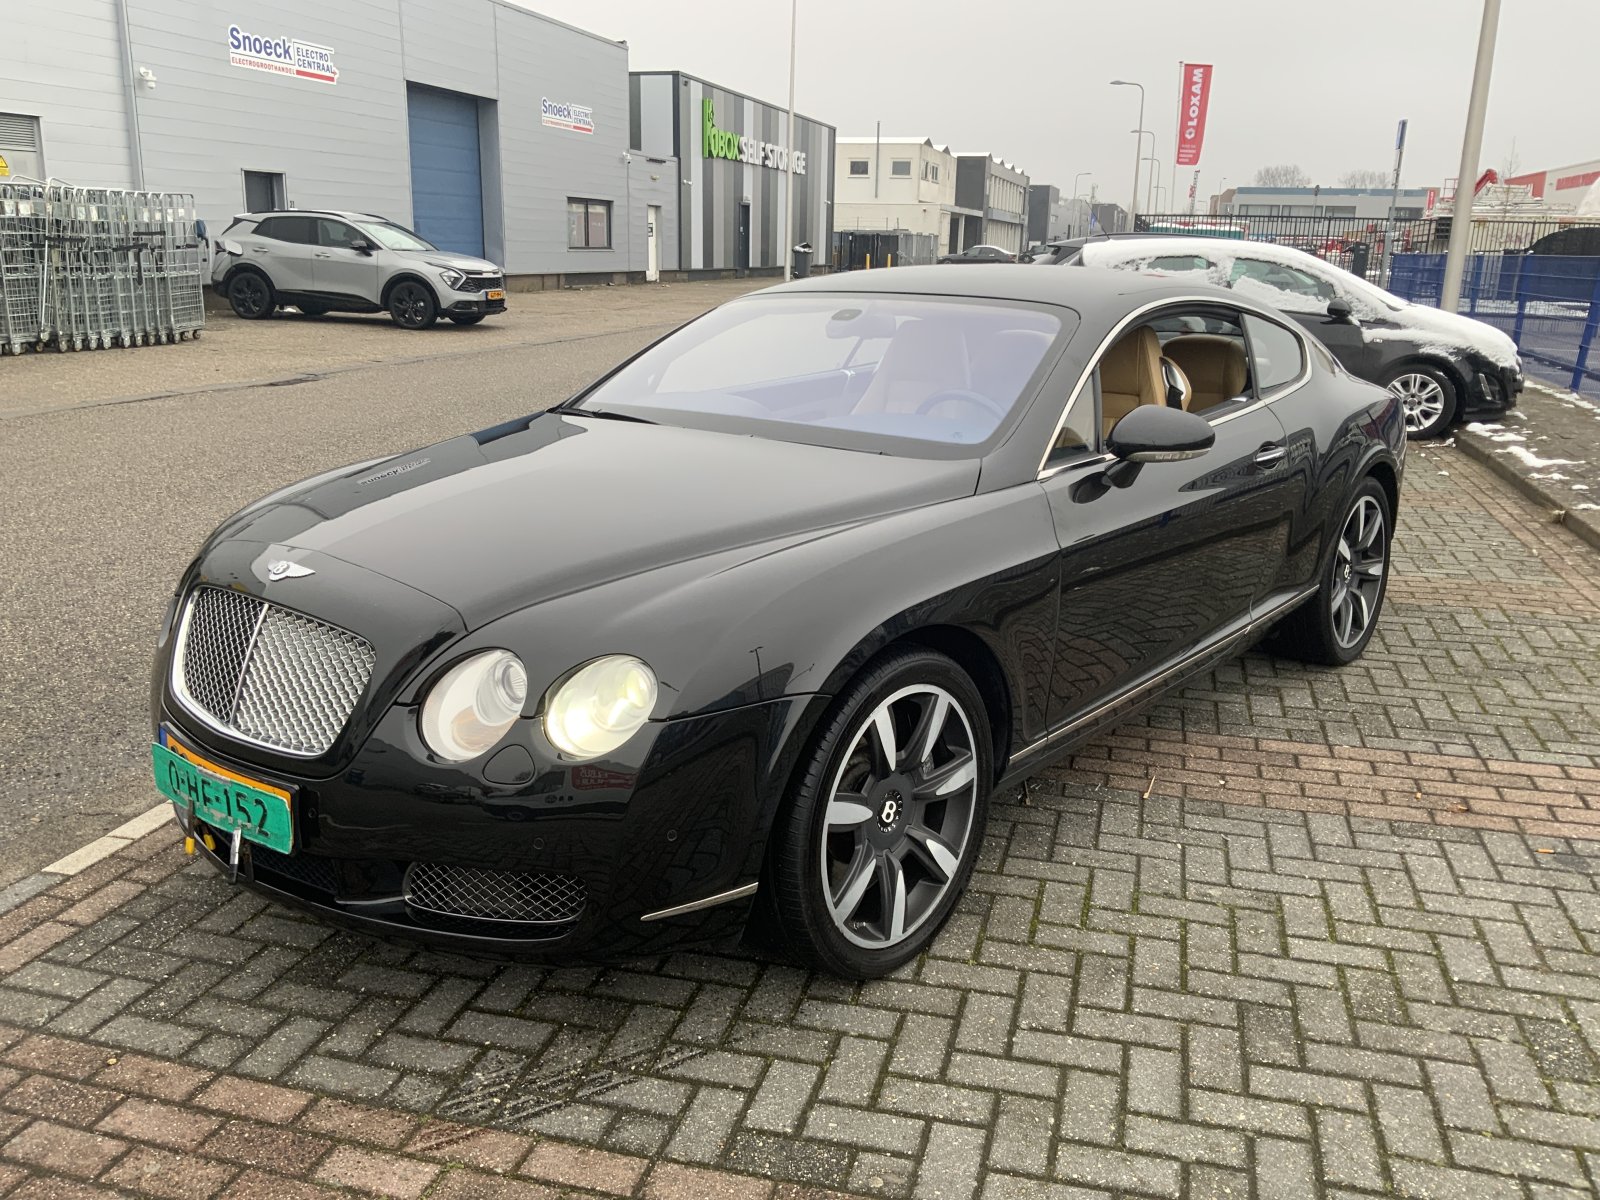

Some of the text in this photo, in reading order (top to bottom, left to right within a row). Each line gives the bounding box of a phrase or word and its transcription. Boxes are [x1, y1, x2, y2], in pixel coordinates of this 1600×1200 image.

[229, 26, 293, 61] Snoeck
[231, 56, 296, 75] ELECTROGROOTHANDEL
[296, 47, 329, 63] ELECTRO
[297, 58, 334, 74] CENTRAAL
[1187, 68, 1204, 126] LOXAM
[542, 98, 572, 119] Snoeck
[881, 800, 897, 823] B
